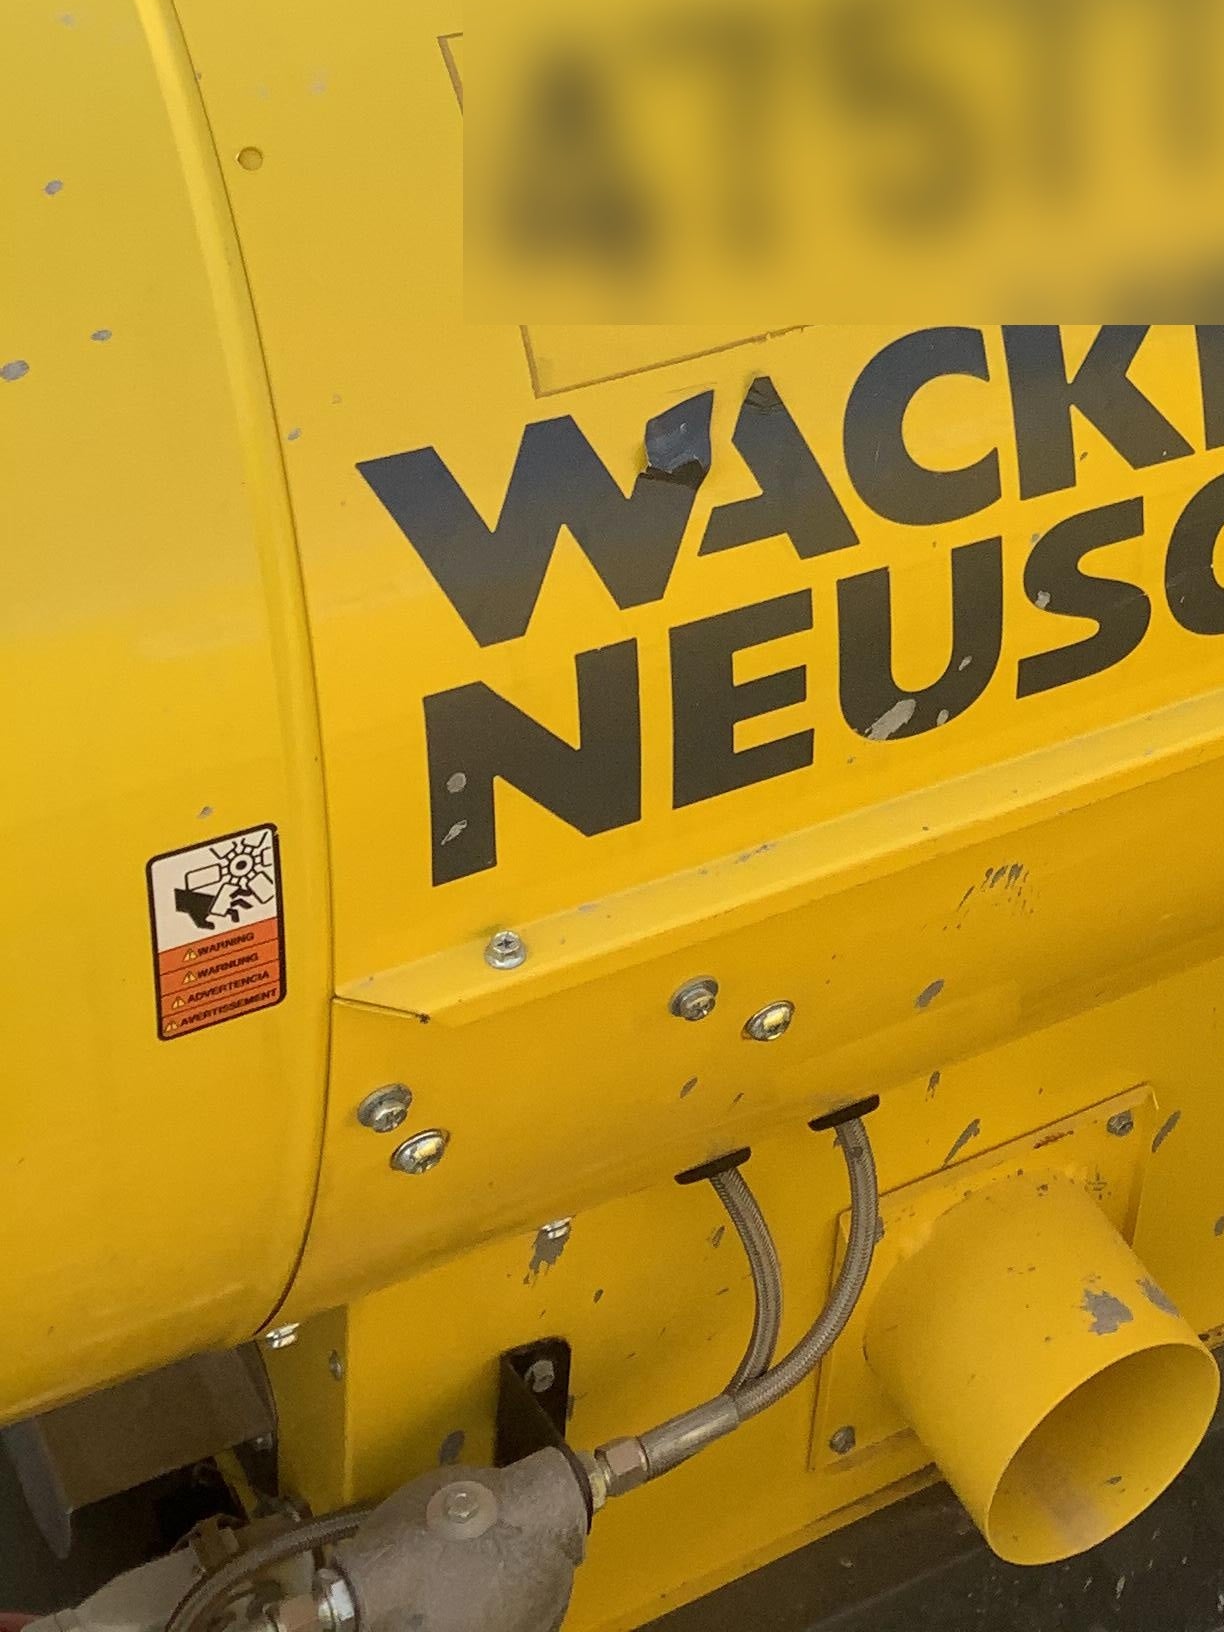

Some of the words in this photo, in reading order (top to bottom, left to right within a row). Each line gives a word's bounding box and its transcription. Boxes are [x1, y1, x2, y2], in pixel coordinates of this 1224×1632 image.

[197, 932, 254, 957] WARNING
[197, 952, 259, 979] WARNUNG
[187, 970, 270, 1004] ADVERTENCIA
[180, 988, 277, 1027] AVERTISSEMENT
